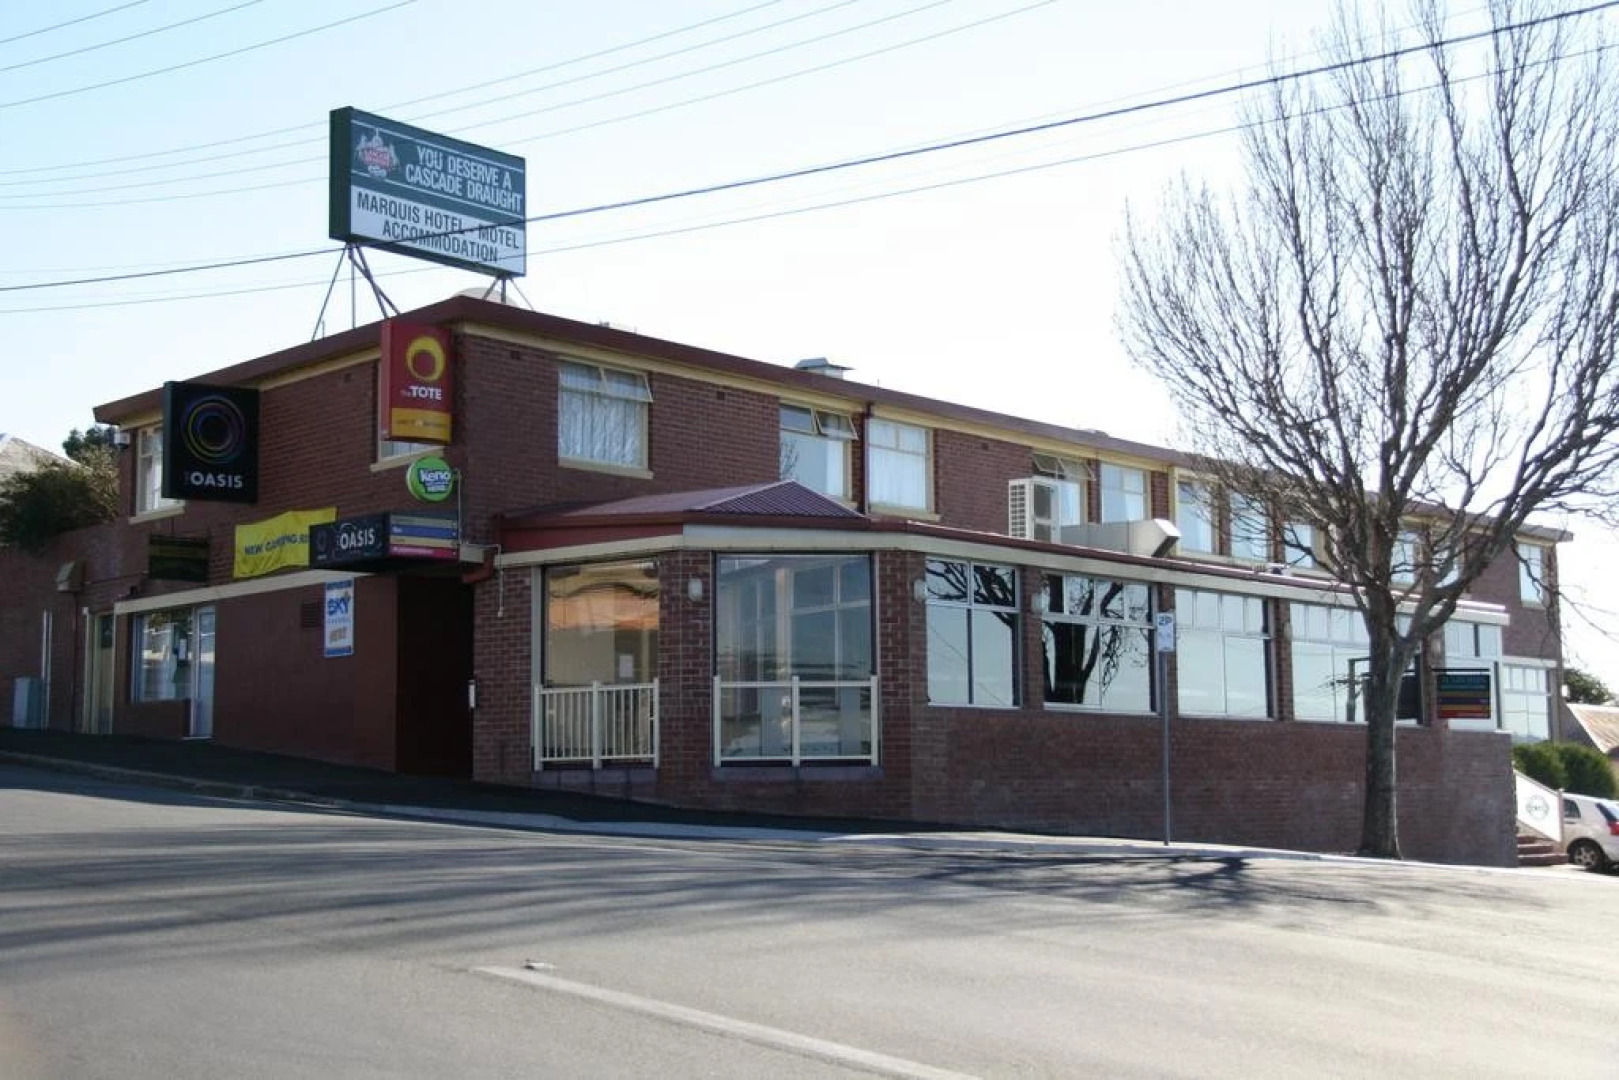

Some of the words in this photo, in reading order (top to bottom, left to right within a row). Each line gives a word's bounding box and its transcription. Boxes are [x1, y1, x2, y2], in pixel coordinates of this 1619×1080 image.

[417, 145, 443, 170] YOU
[448, 156, 499, 187] DESERVE
[502, 171, 513, 190] A
[405, 163, 463, 197] CASCADE
[467, 181, 523, 213] DRAUGHT
[357, 191, 421, 224] MARQUIS
[424, 208, 465, 235] HOTEL
[478, 223, 519, 249] MOTEL
[382, 219, 498, 262] ACCOMMODATION
[410, 385, 442, 400] TOTE
[190, 471, 243, 488] OASIS
[244, 543, 264, 556] NEW
[340, 527, 376, 550] OASIS
[327, 595, 351, 616] SKY
